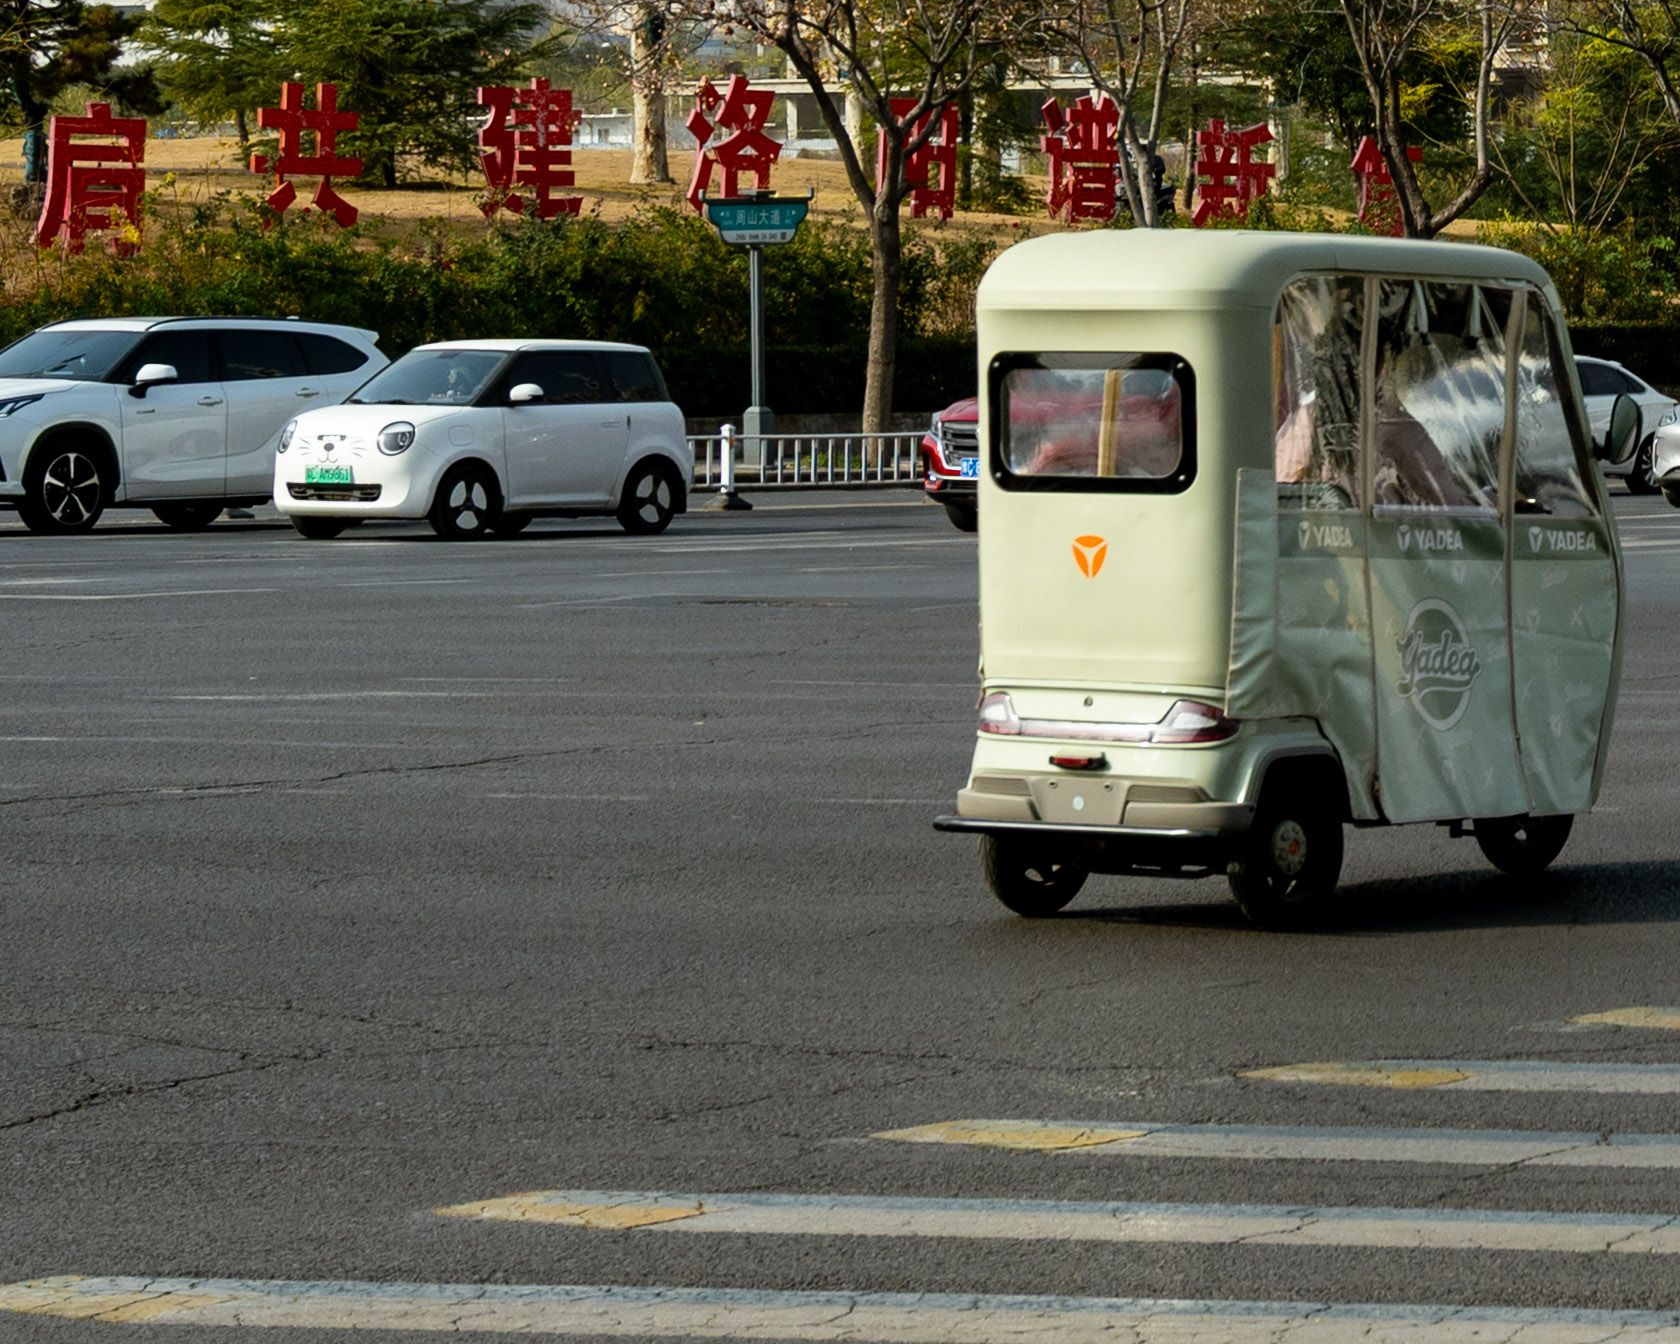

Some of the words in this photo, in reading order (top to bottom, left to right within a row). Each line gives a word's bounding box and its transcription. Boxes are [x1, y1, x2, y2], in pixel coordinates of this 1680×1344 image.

[735, 208, 781, 226] 周山大道
[1415, 529, 1464, 551] YADEA
[1546, 529, 1597, 552] YADEA
[1397, 629, 1480, 699] Yadea
